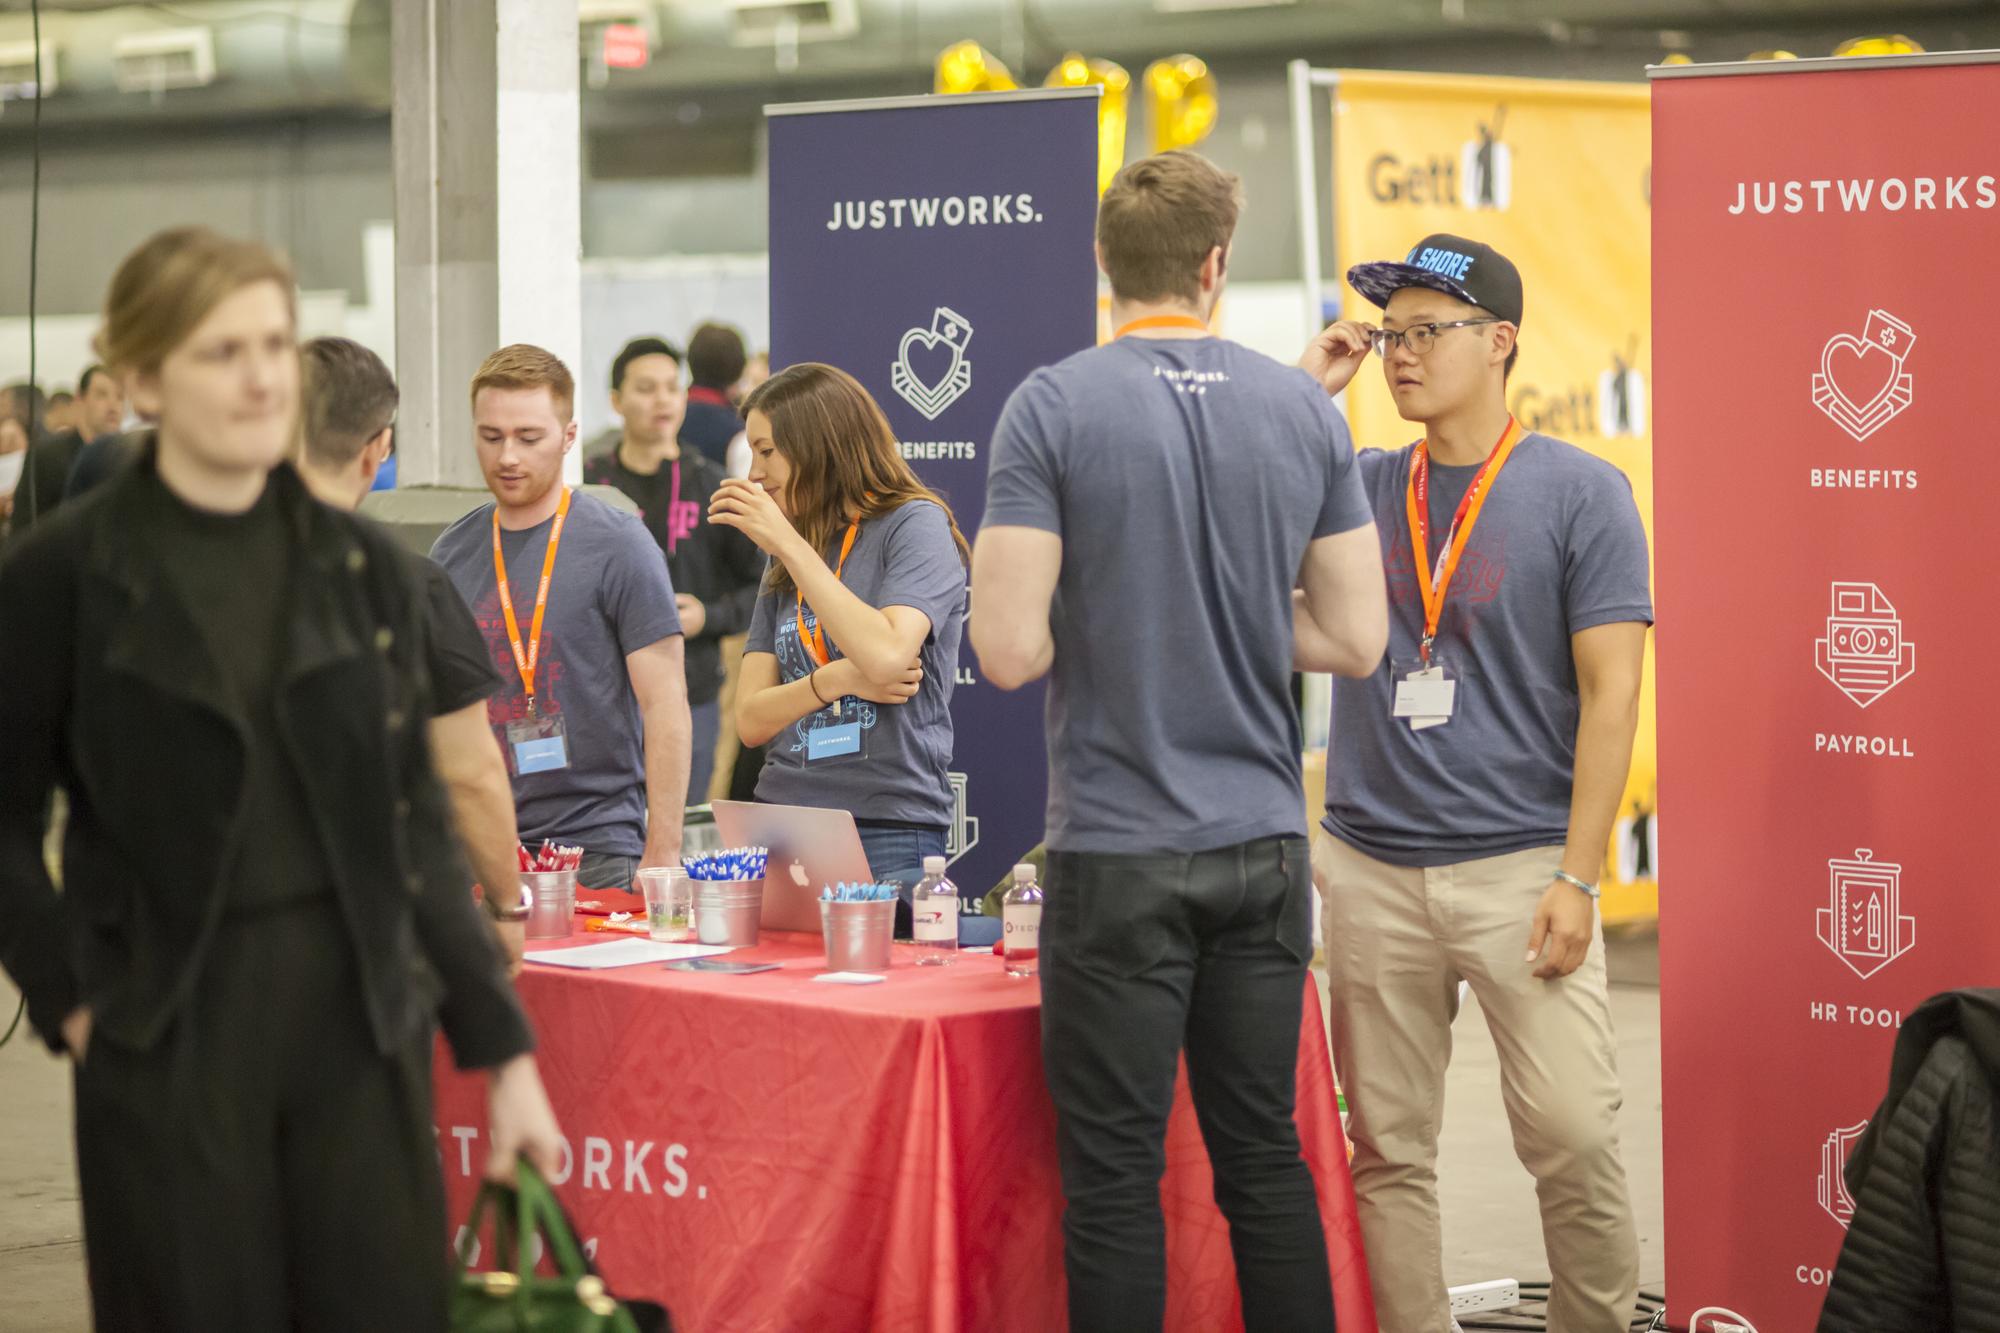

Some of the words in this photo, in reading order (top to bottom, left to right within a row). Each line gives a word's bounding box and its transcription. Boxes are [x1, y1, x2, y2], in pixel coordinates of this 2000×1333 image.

[1368, 152, 1459, 206] Gett
[1728, 175, 1998, 215] JUSTWORKS
[826, 193, 1043, 231] JUSTWORKS.
[1416, 248, 1474, 281] SHORE
[1810, 468, 1918, 489] BENEFITS
[1815, 733, 1914, 757] PAYROLL
[1811, 1001, 1837, 1022] HR
